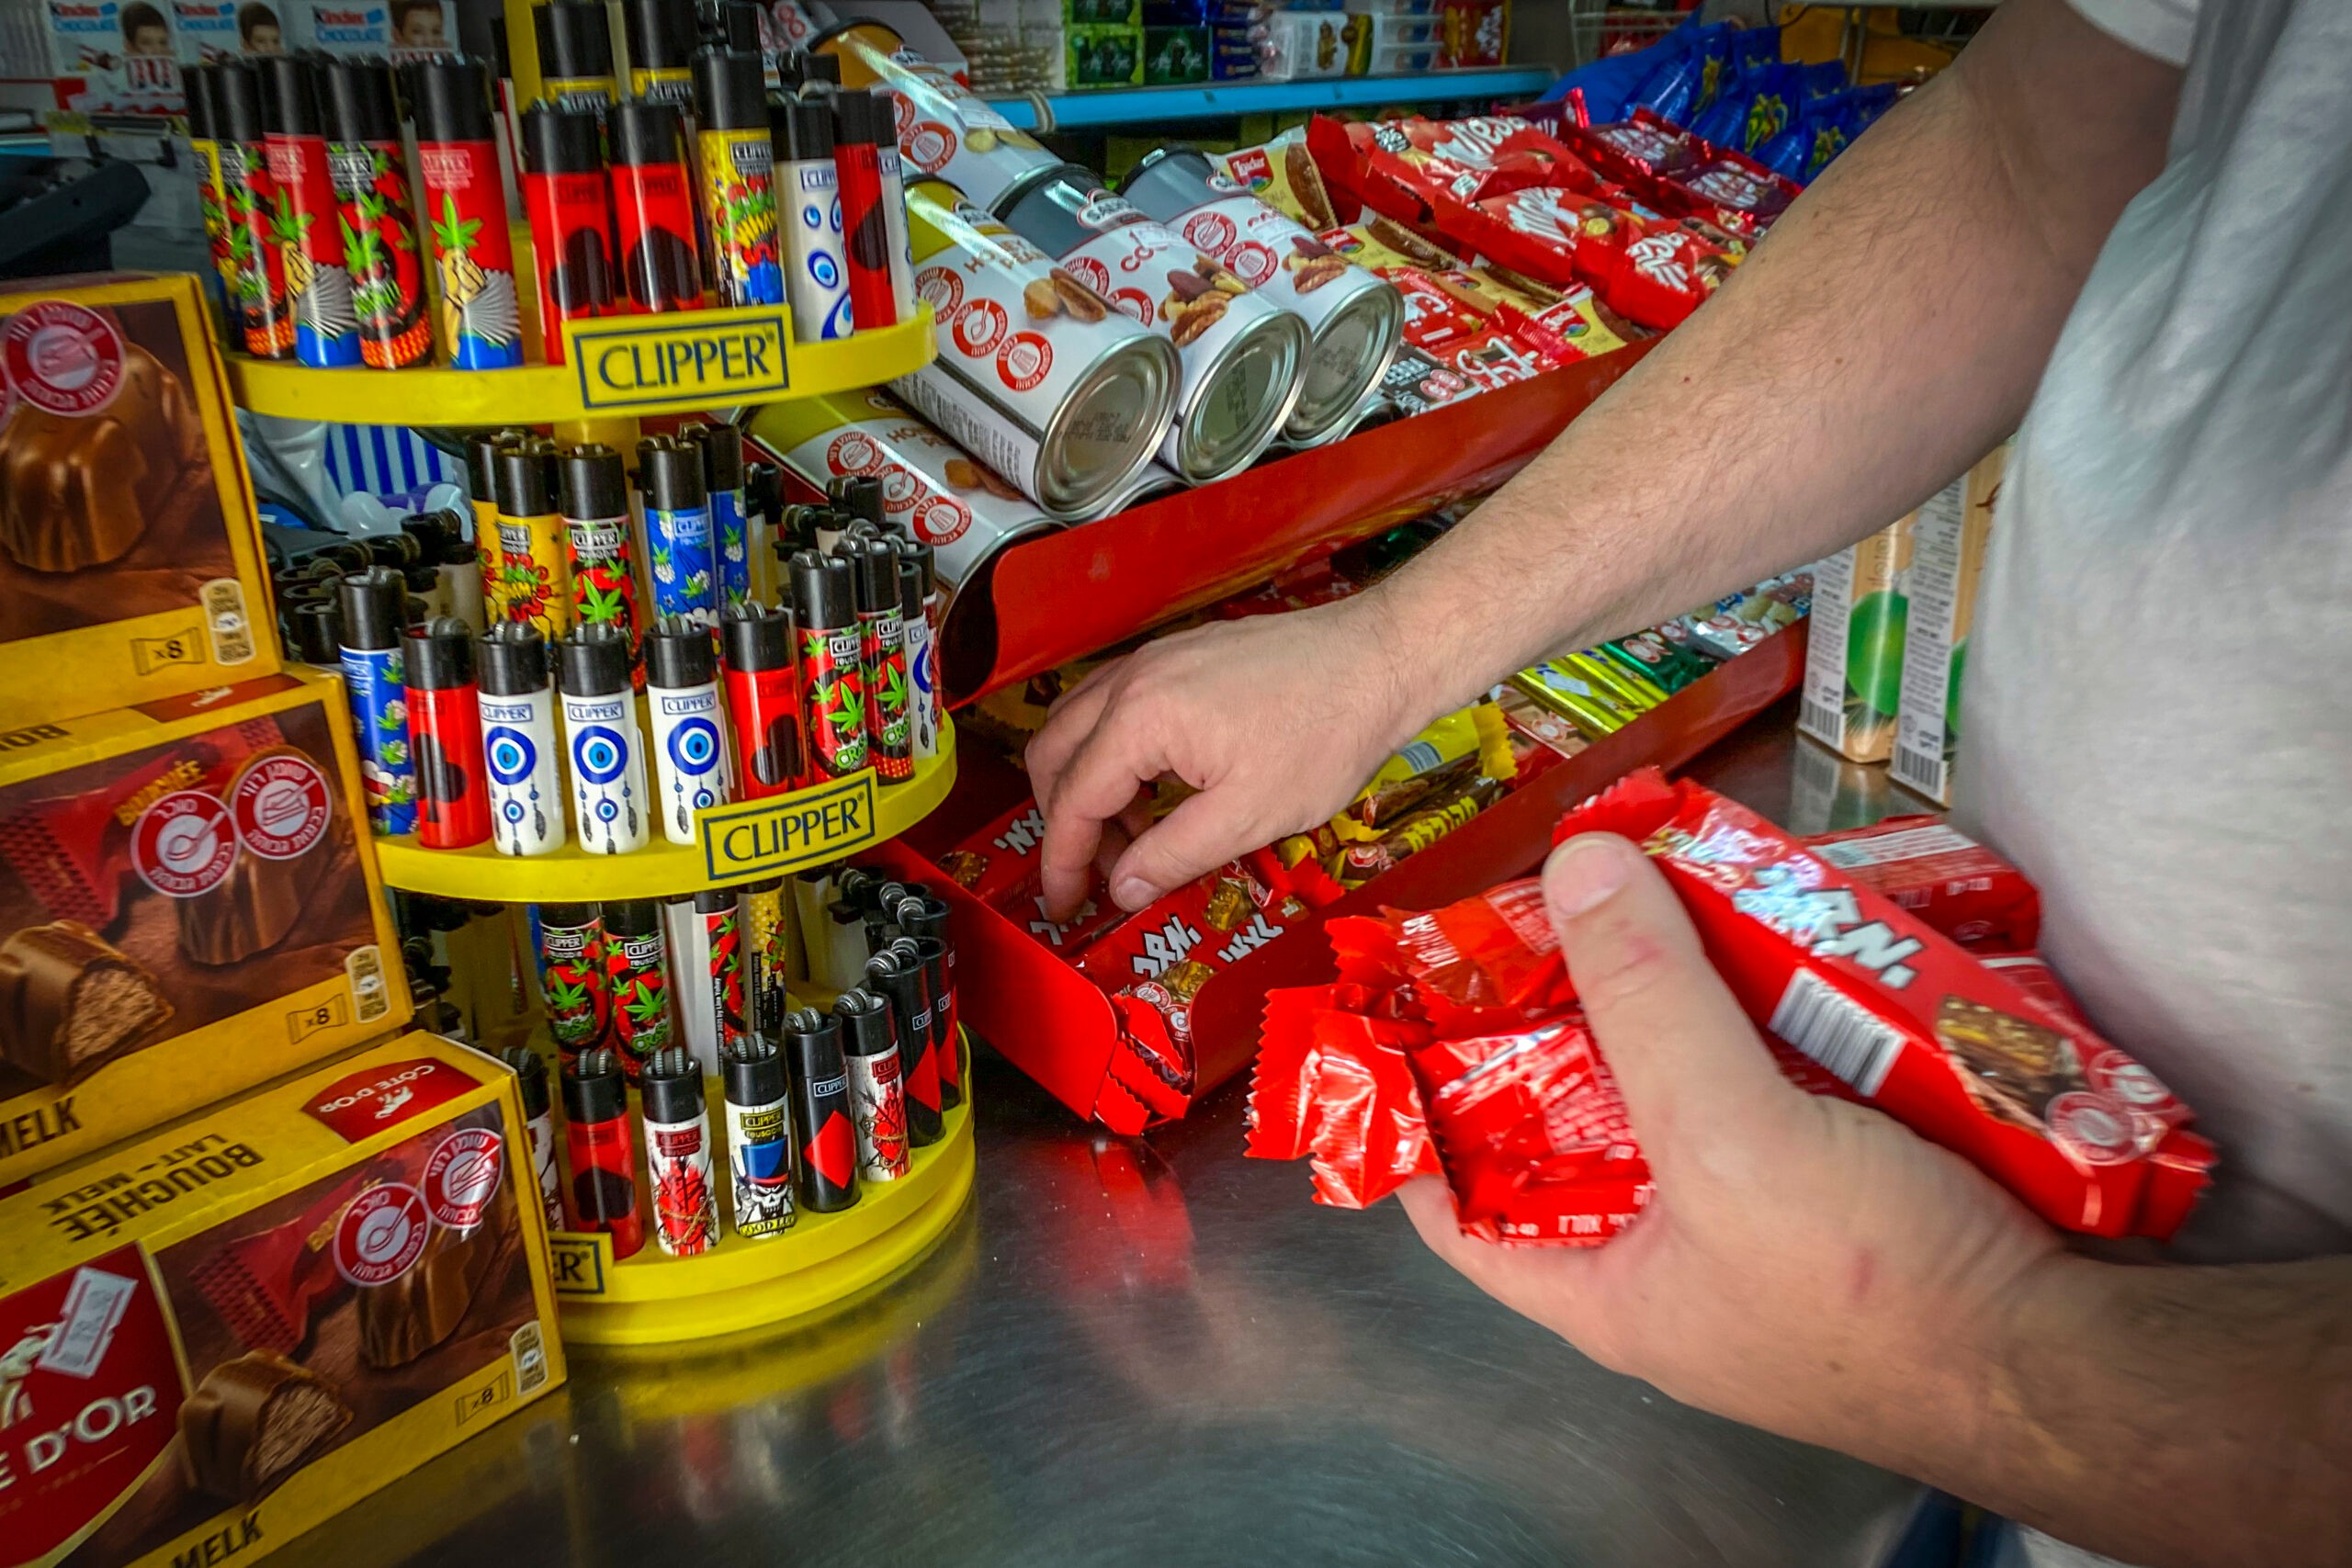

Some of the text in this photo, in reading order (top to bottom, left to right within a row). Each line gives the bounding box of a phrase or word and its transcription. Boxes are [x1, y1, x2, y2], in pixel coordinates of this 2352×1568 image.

[598, 333, 770, 390] CLIPPER
[571, 703, 621, 720] CLIPPER
[667, 694, 714, 712] CLIPPER
[659, 1129, 699, 1146] CLIPPER
[25, 1383, 158, 1475] D'OR
